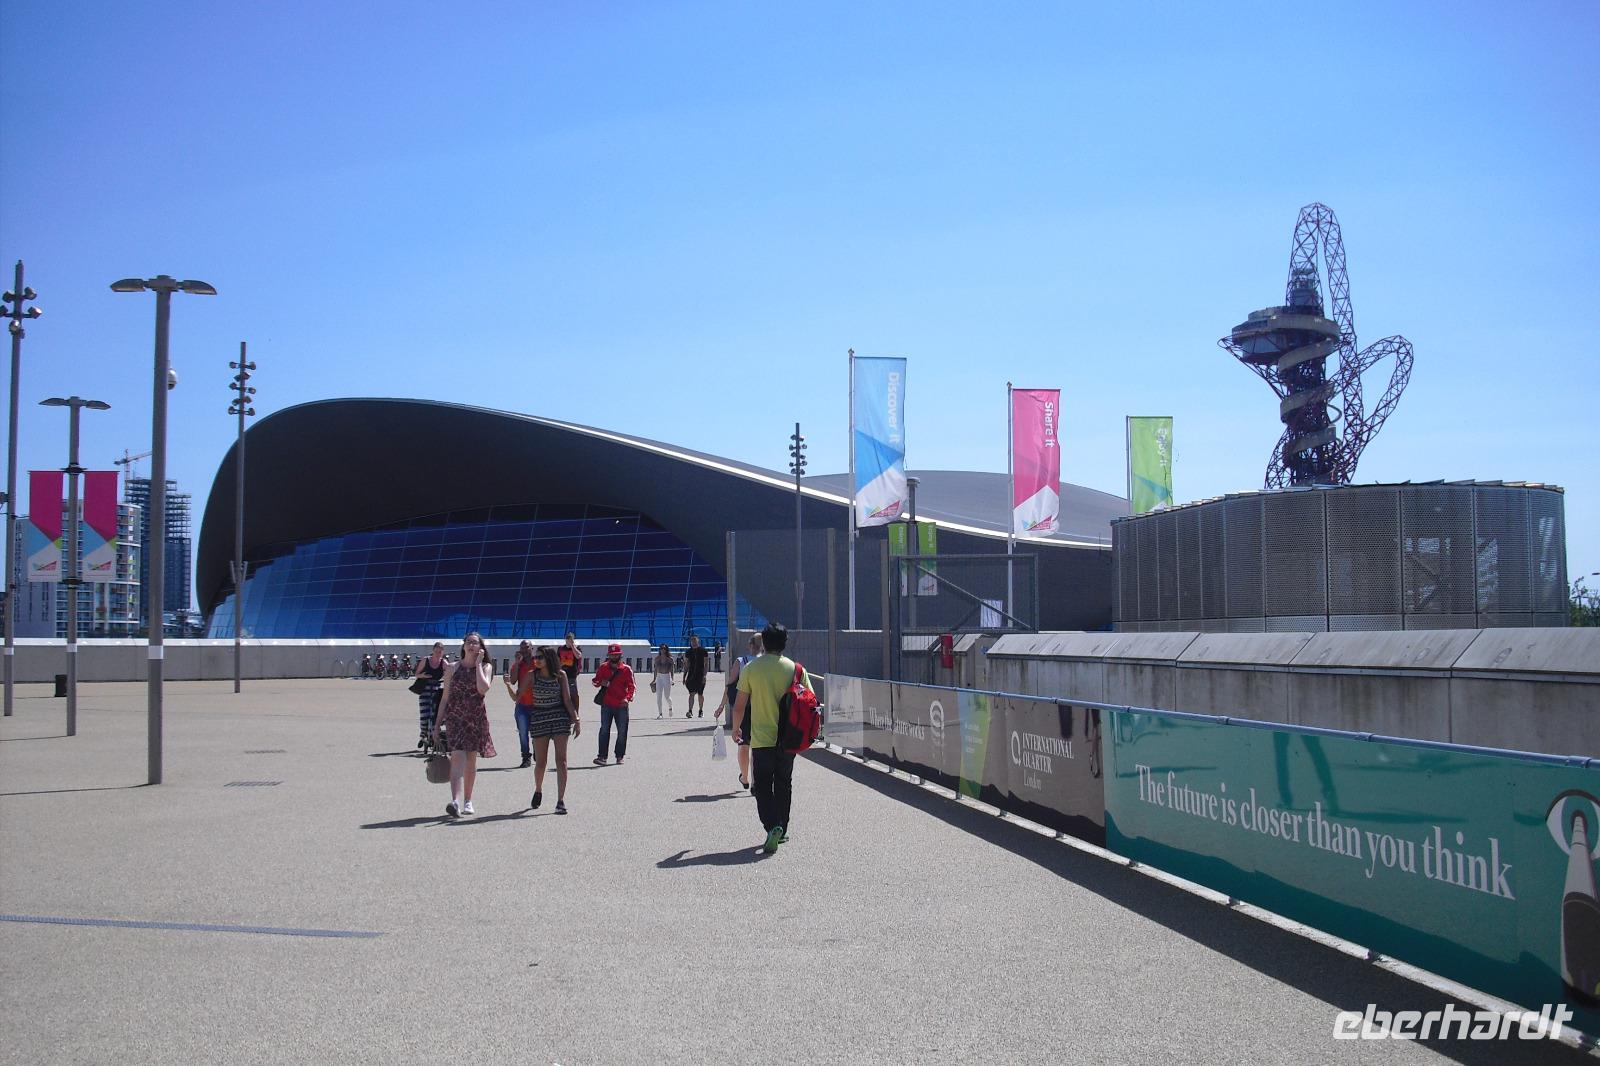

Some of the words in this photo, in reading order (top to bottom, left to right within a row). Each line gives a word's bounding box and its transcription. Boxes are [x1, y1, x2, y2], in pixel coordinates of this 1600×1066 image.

[887, 372, 900, 430] Discover
[1045, 401, 1054, 436] Share
[1022, 731, 1075, 760] INTERNATIONAL
[1022, 750, 1053, 775] QUARTER
[1023, 768, 1042, 792] London
[1135, 763, 1165, 807] The
[1167, 770, 1218, 821] future
[1220, 782, 1237, 826] is
[1240, 787, 1303, 843] closer
[1306, 801, 1363, 860] than
[1364, 831, 1417, 879] you
[1421, 825, 1516, 900] think
